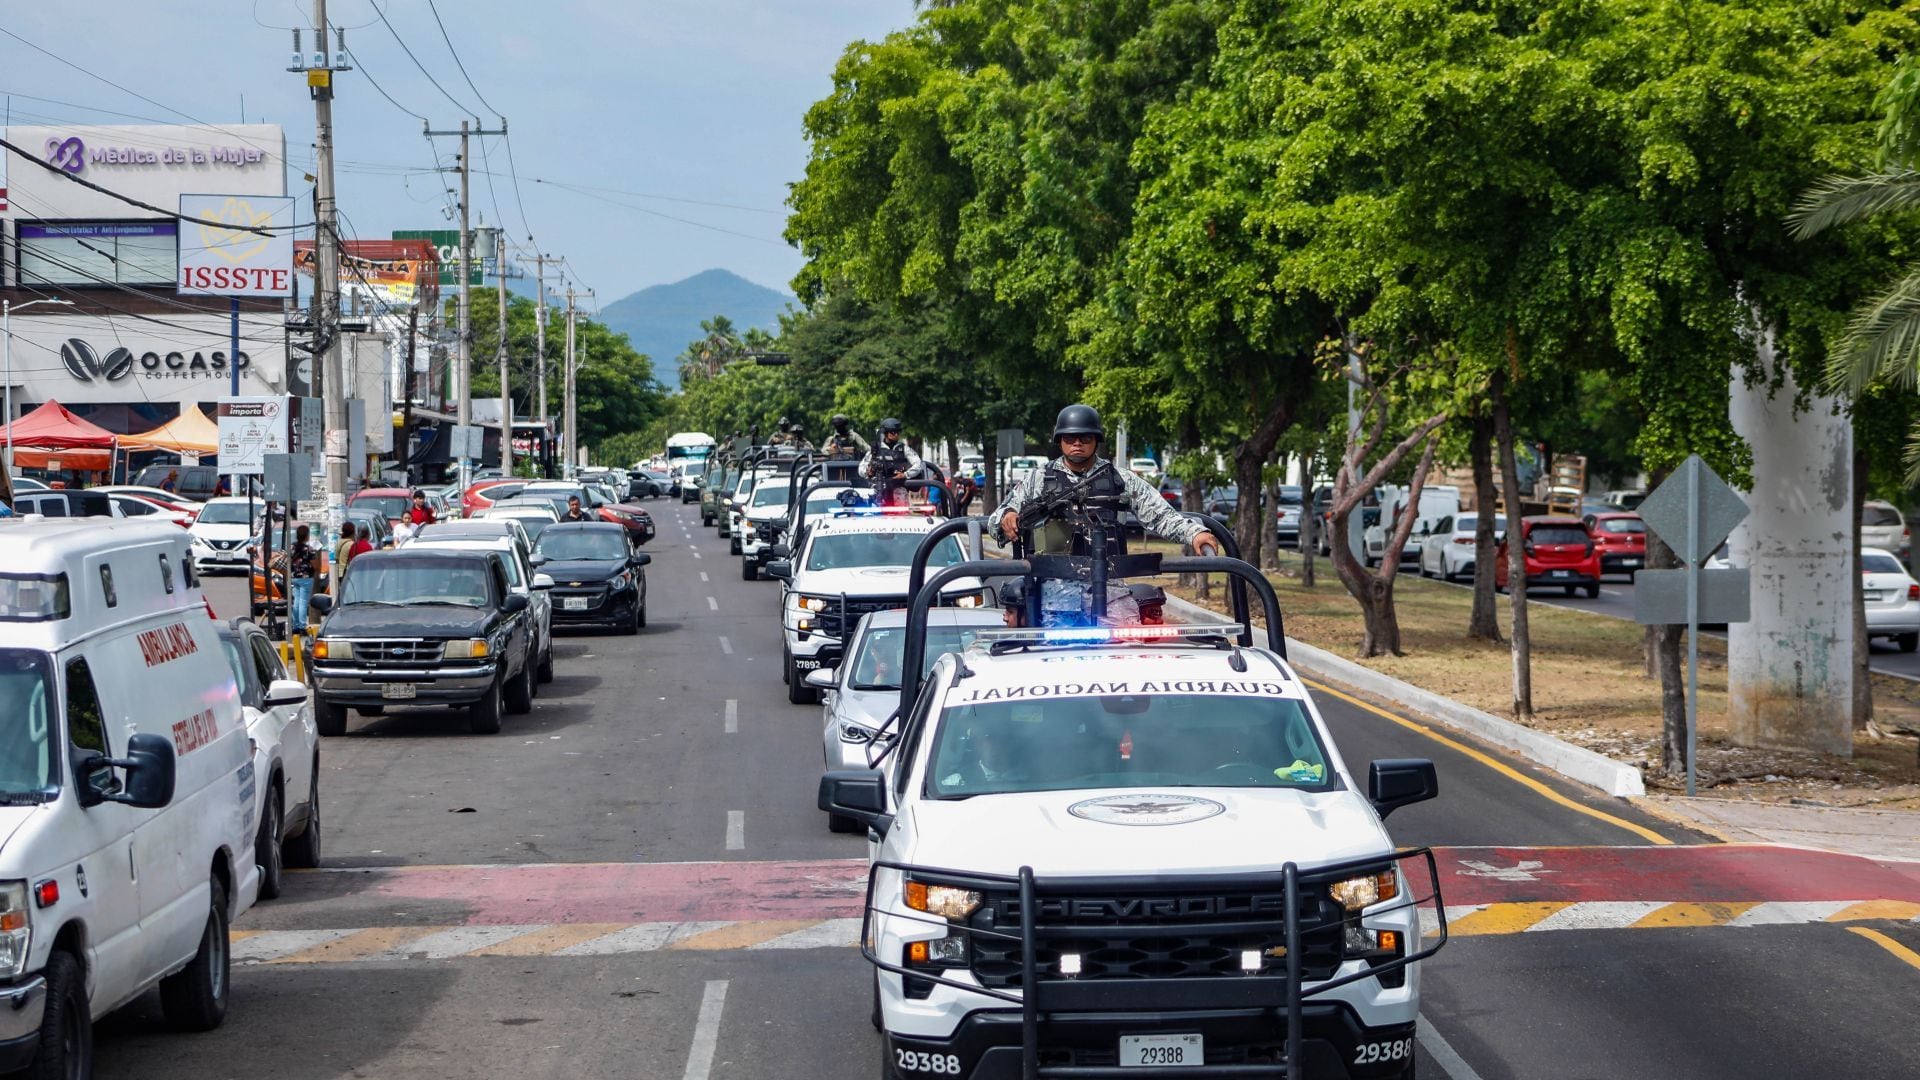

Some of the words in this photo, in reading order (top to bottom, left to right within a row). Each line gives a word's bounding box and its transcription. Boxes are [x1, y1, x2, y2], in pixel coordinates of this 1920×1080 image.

[91, 147, 157, 164] Médica
[161, 148, 185, 164] de
[190, 149, 206, 164] la
[211, 147, 265, 166] Mujer
[183, 266, 289, 290] ISSSTE
[140, 351, 250, 370] OCASO
[145, 371, 197, 380] COFFEE
[205, 371, 249, 380] HOUE
[230, 407, 262, 416] importa
[136, 622, 199, 668] AMBULANCIA
[795, 659, 822, 670] 27892
[1140, 1046, 1184, 1065] 29388
[1353, 1037, 1412, 1064] 29388
[896, 1048, 961, 1075] 29388
